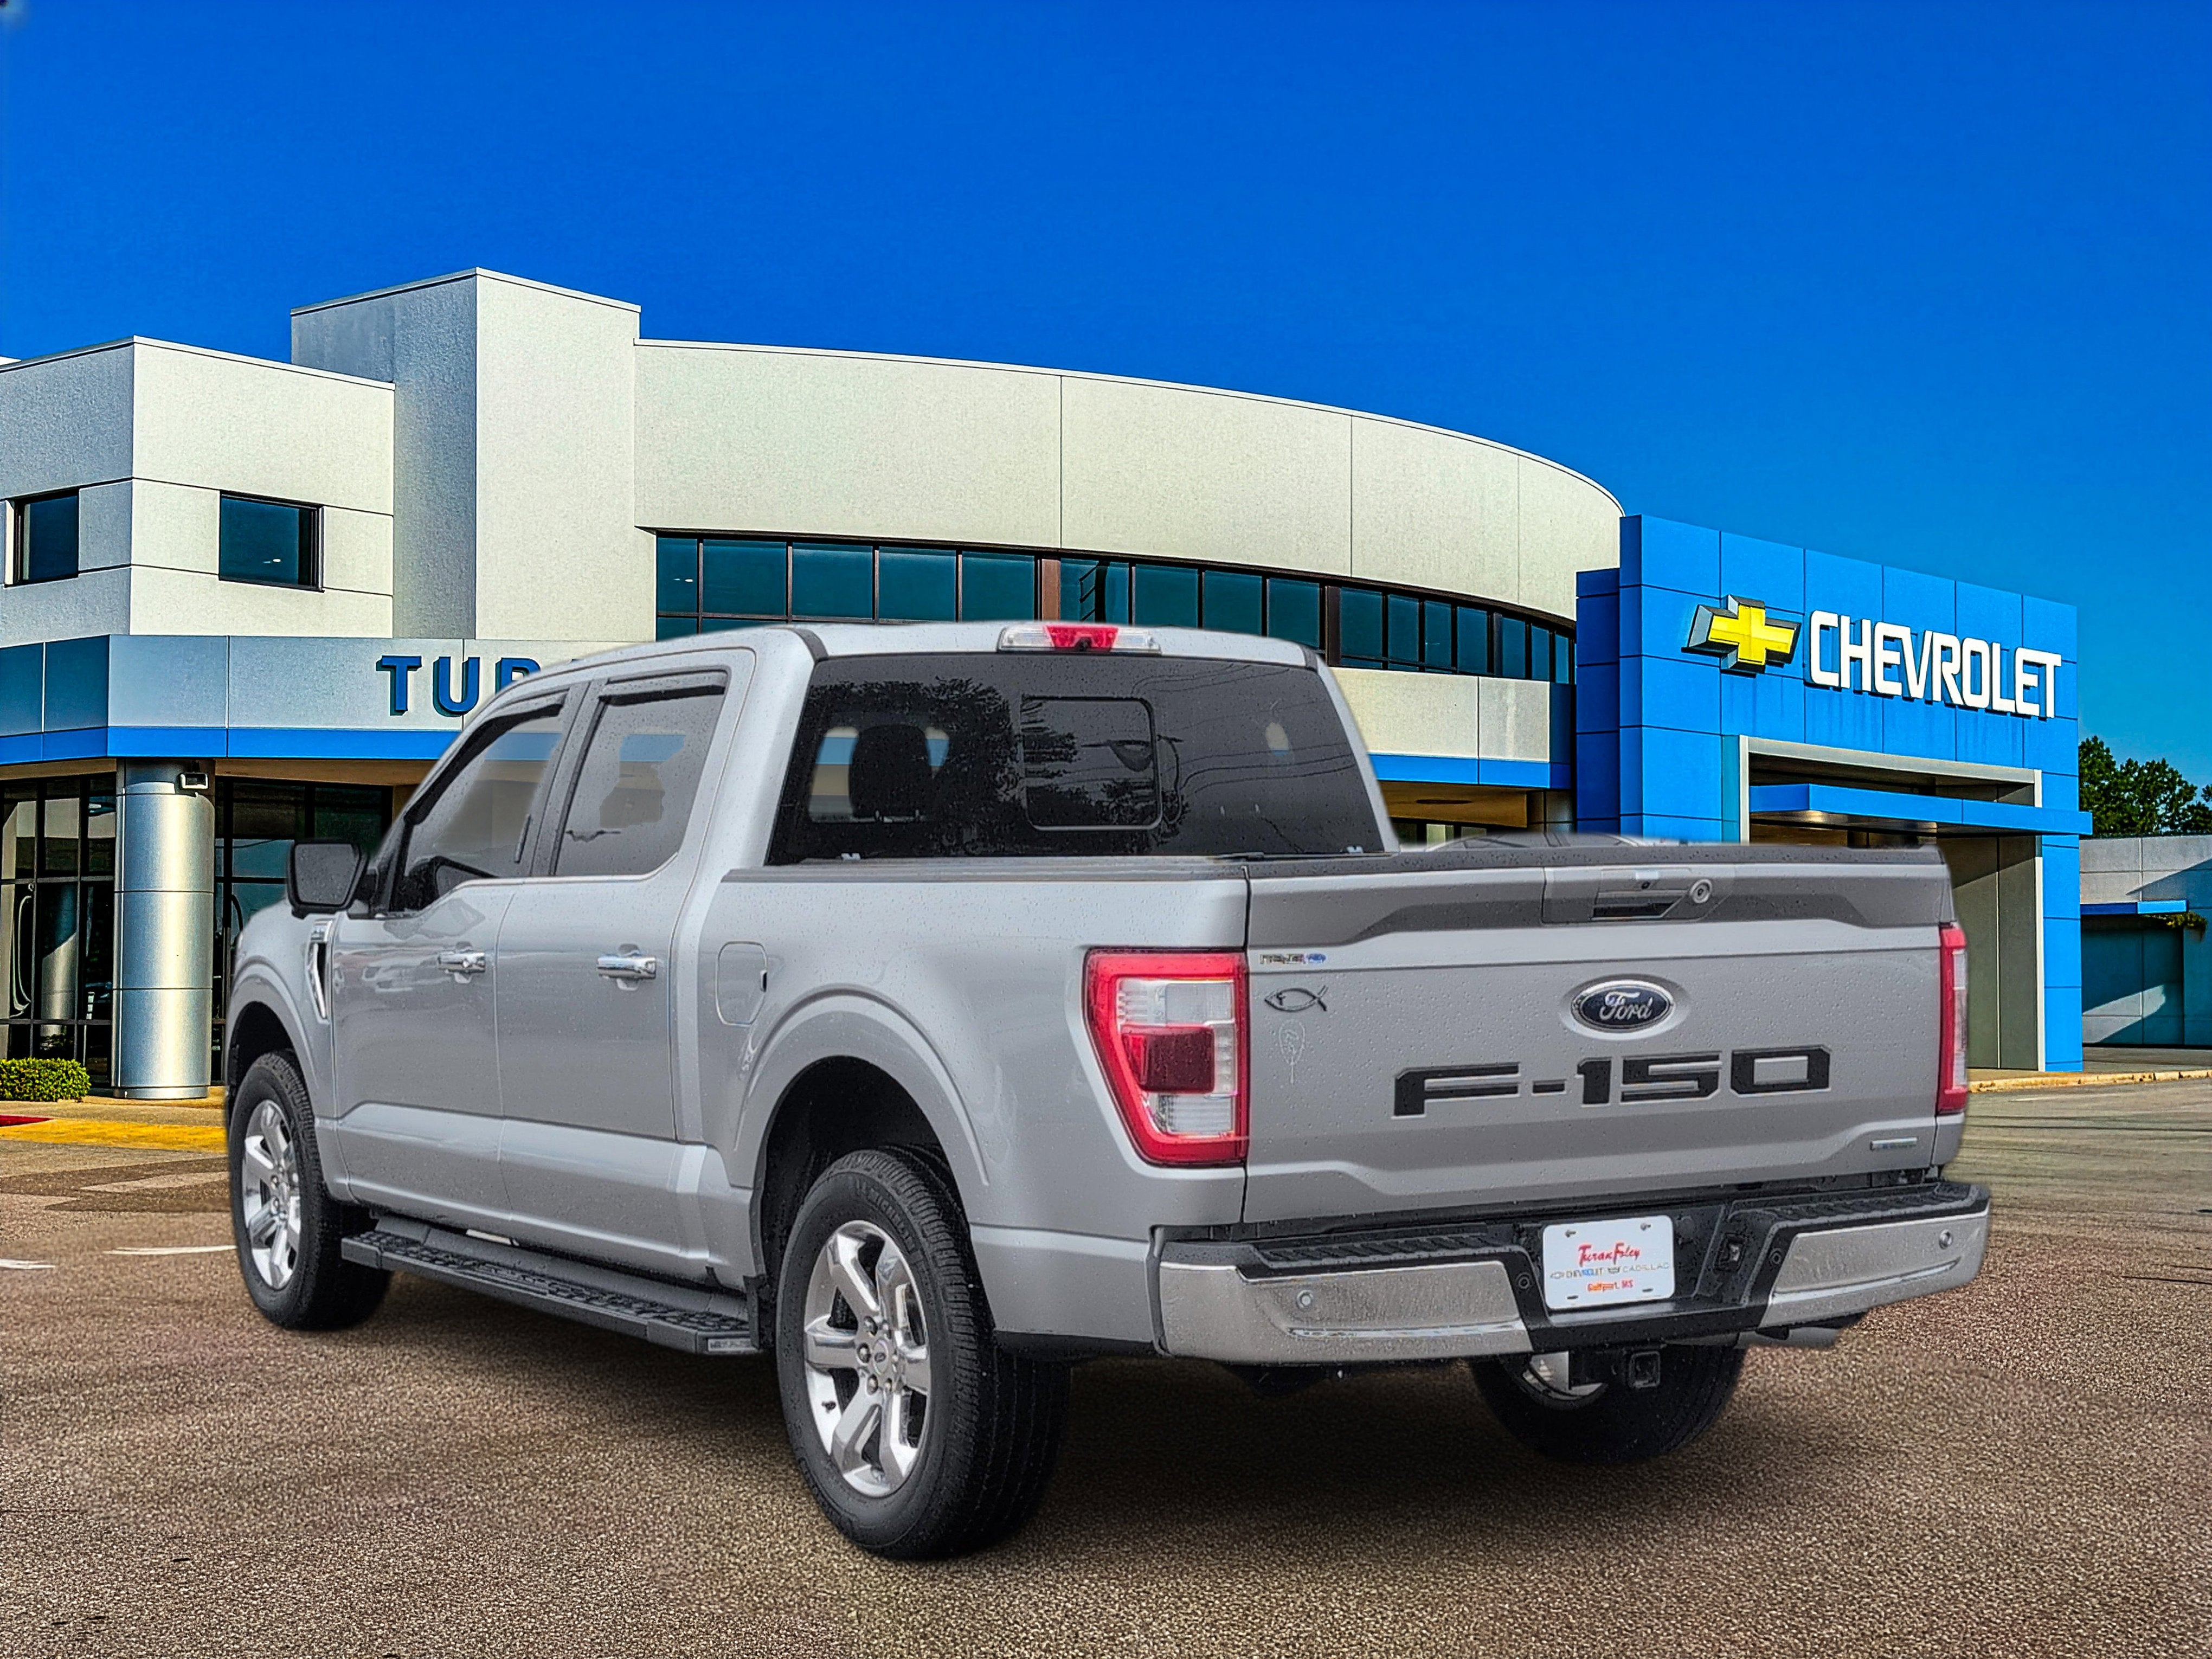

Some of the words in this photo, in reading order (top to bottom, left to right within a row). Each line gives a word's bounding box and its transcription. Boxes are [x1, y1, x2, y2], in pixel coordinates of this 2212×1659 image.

[1809, 610, 2062, 718] CHEVROLET
[1600, 992, 1652, 1020] Ford
[1392, 1045, 1831, 1118] F-150
